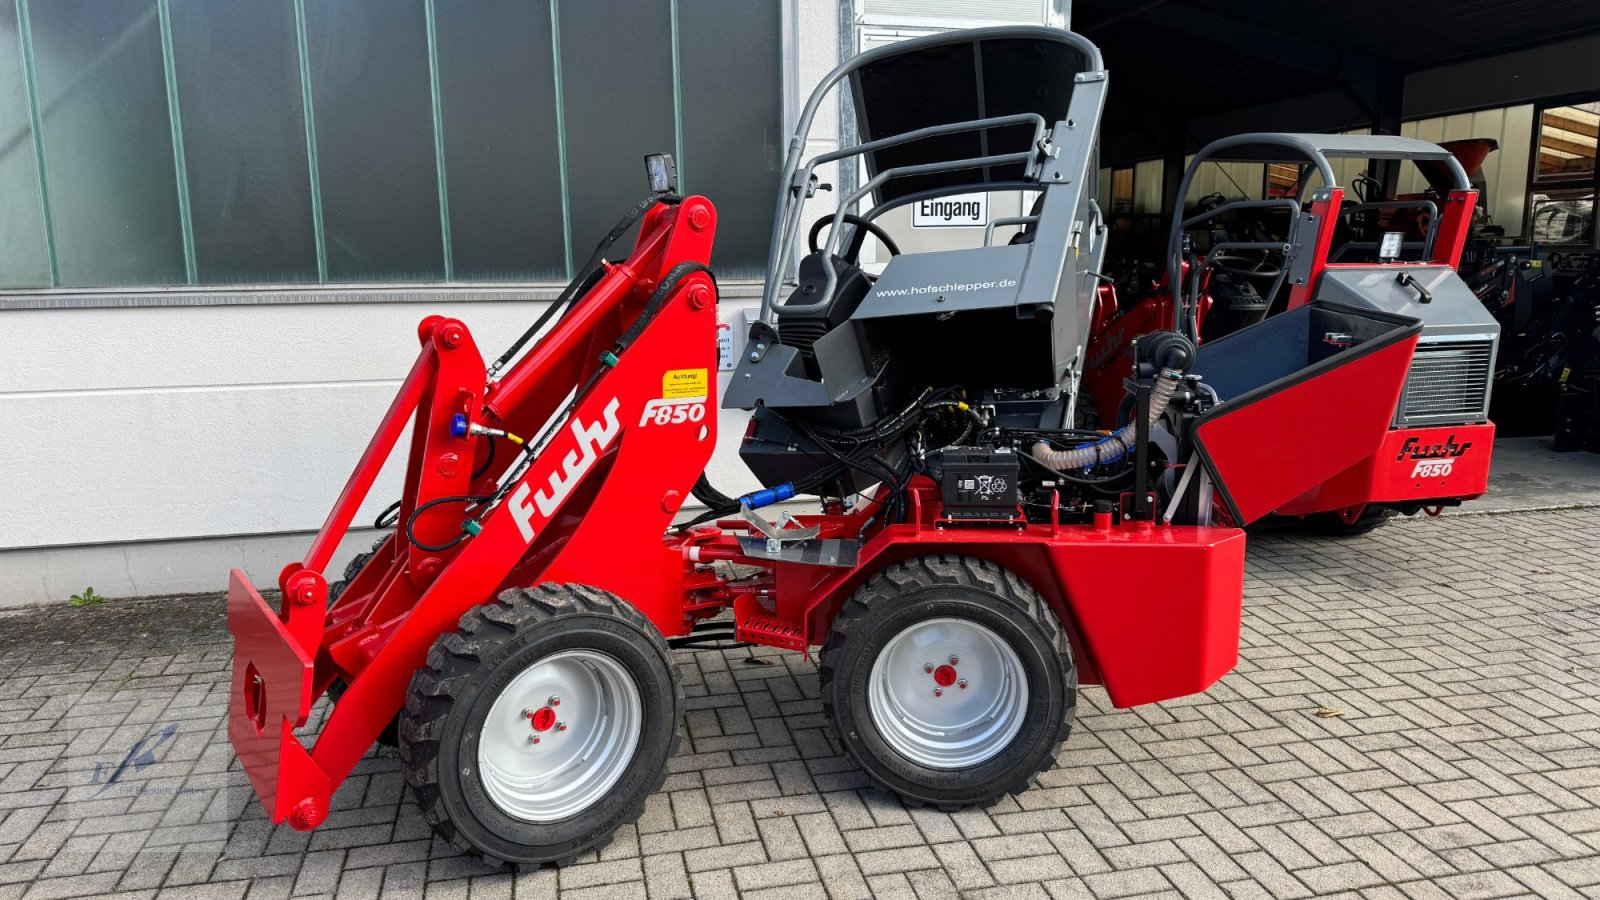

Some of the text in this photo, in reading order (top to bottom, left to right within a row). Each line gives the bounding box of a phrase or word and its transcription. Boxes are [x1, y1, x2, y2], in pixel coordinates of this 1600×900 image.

[920, 199, 981, 221] Eingang
[876, 279, 1017, 297] www.hofschlepper.de
[638, 396, 707, 427] F850
[1397, 434, 1472, 460] Fuchs
[508, 396, 620, 544] Fuchs
[1411, 459, 1455, 478] F850
